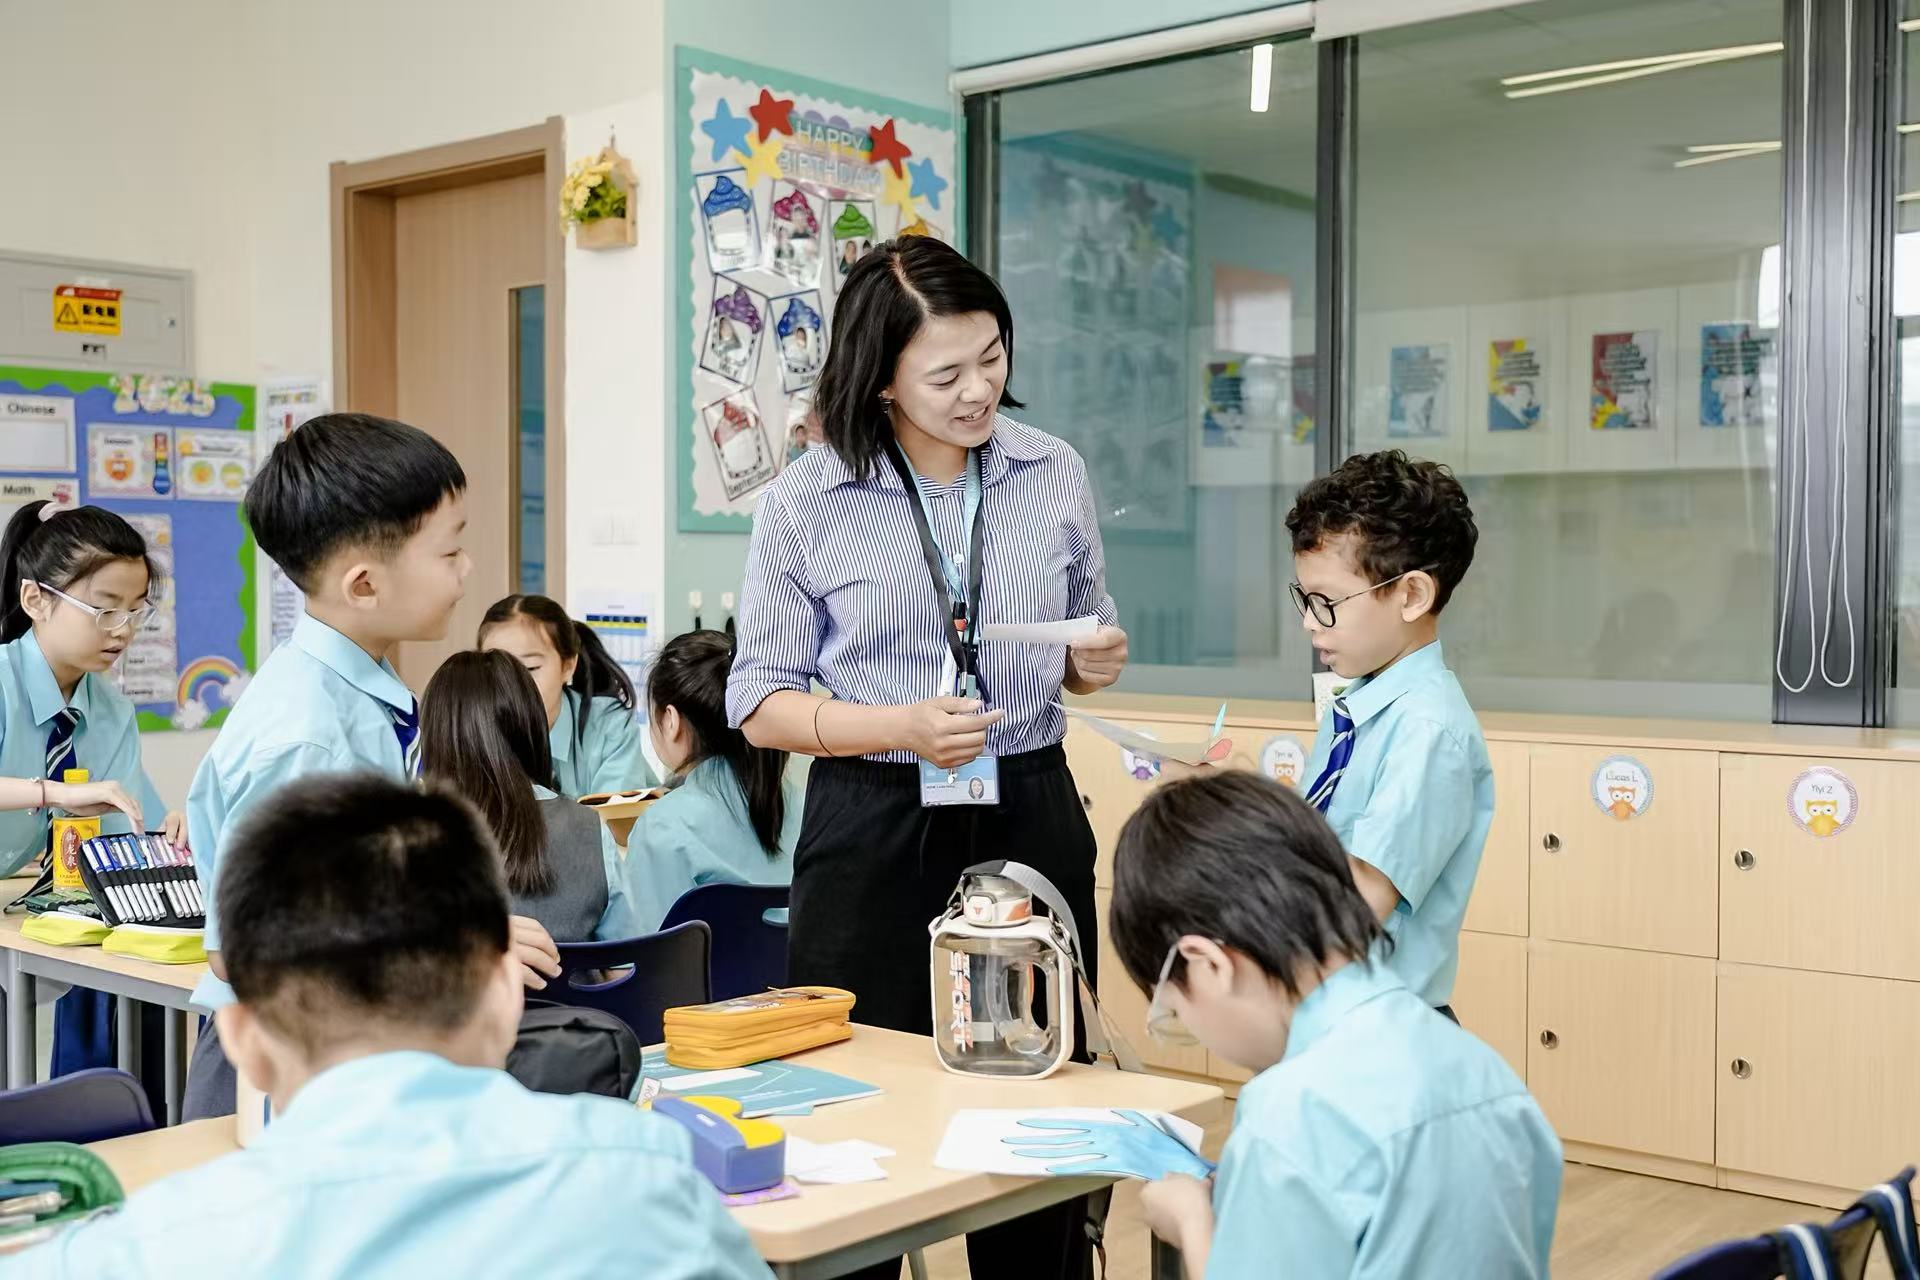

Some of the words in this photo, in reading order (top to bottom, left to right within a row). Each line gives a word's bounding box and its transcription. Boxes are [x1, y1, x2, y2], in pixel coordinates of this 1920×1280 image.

[796, 119, 865, 152] HAPPY
[779, 149, 882, 187] BIRTHDAY
[7, 402, 56, 416] Chinese
[3, 484, 36, 496] Math
[728, 467, 771, 495] September
[1605, 771, 1631, 782] Lucas
